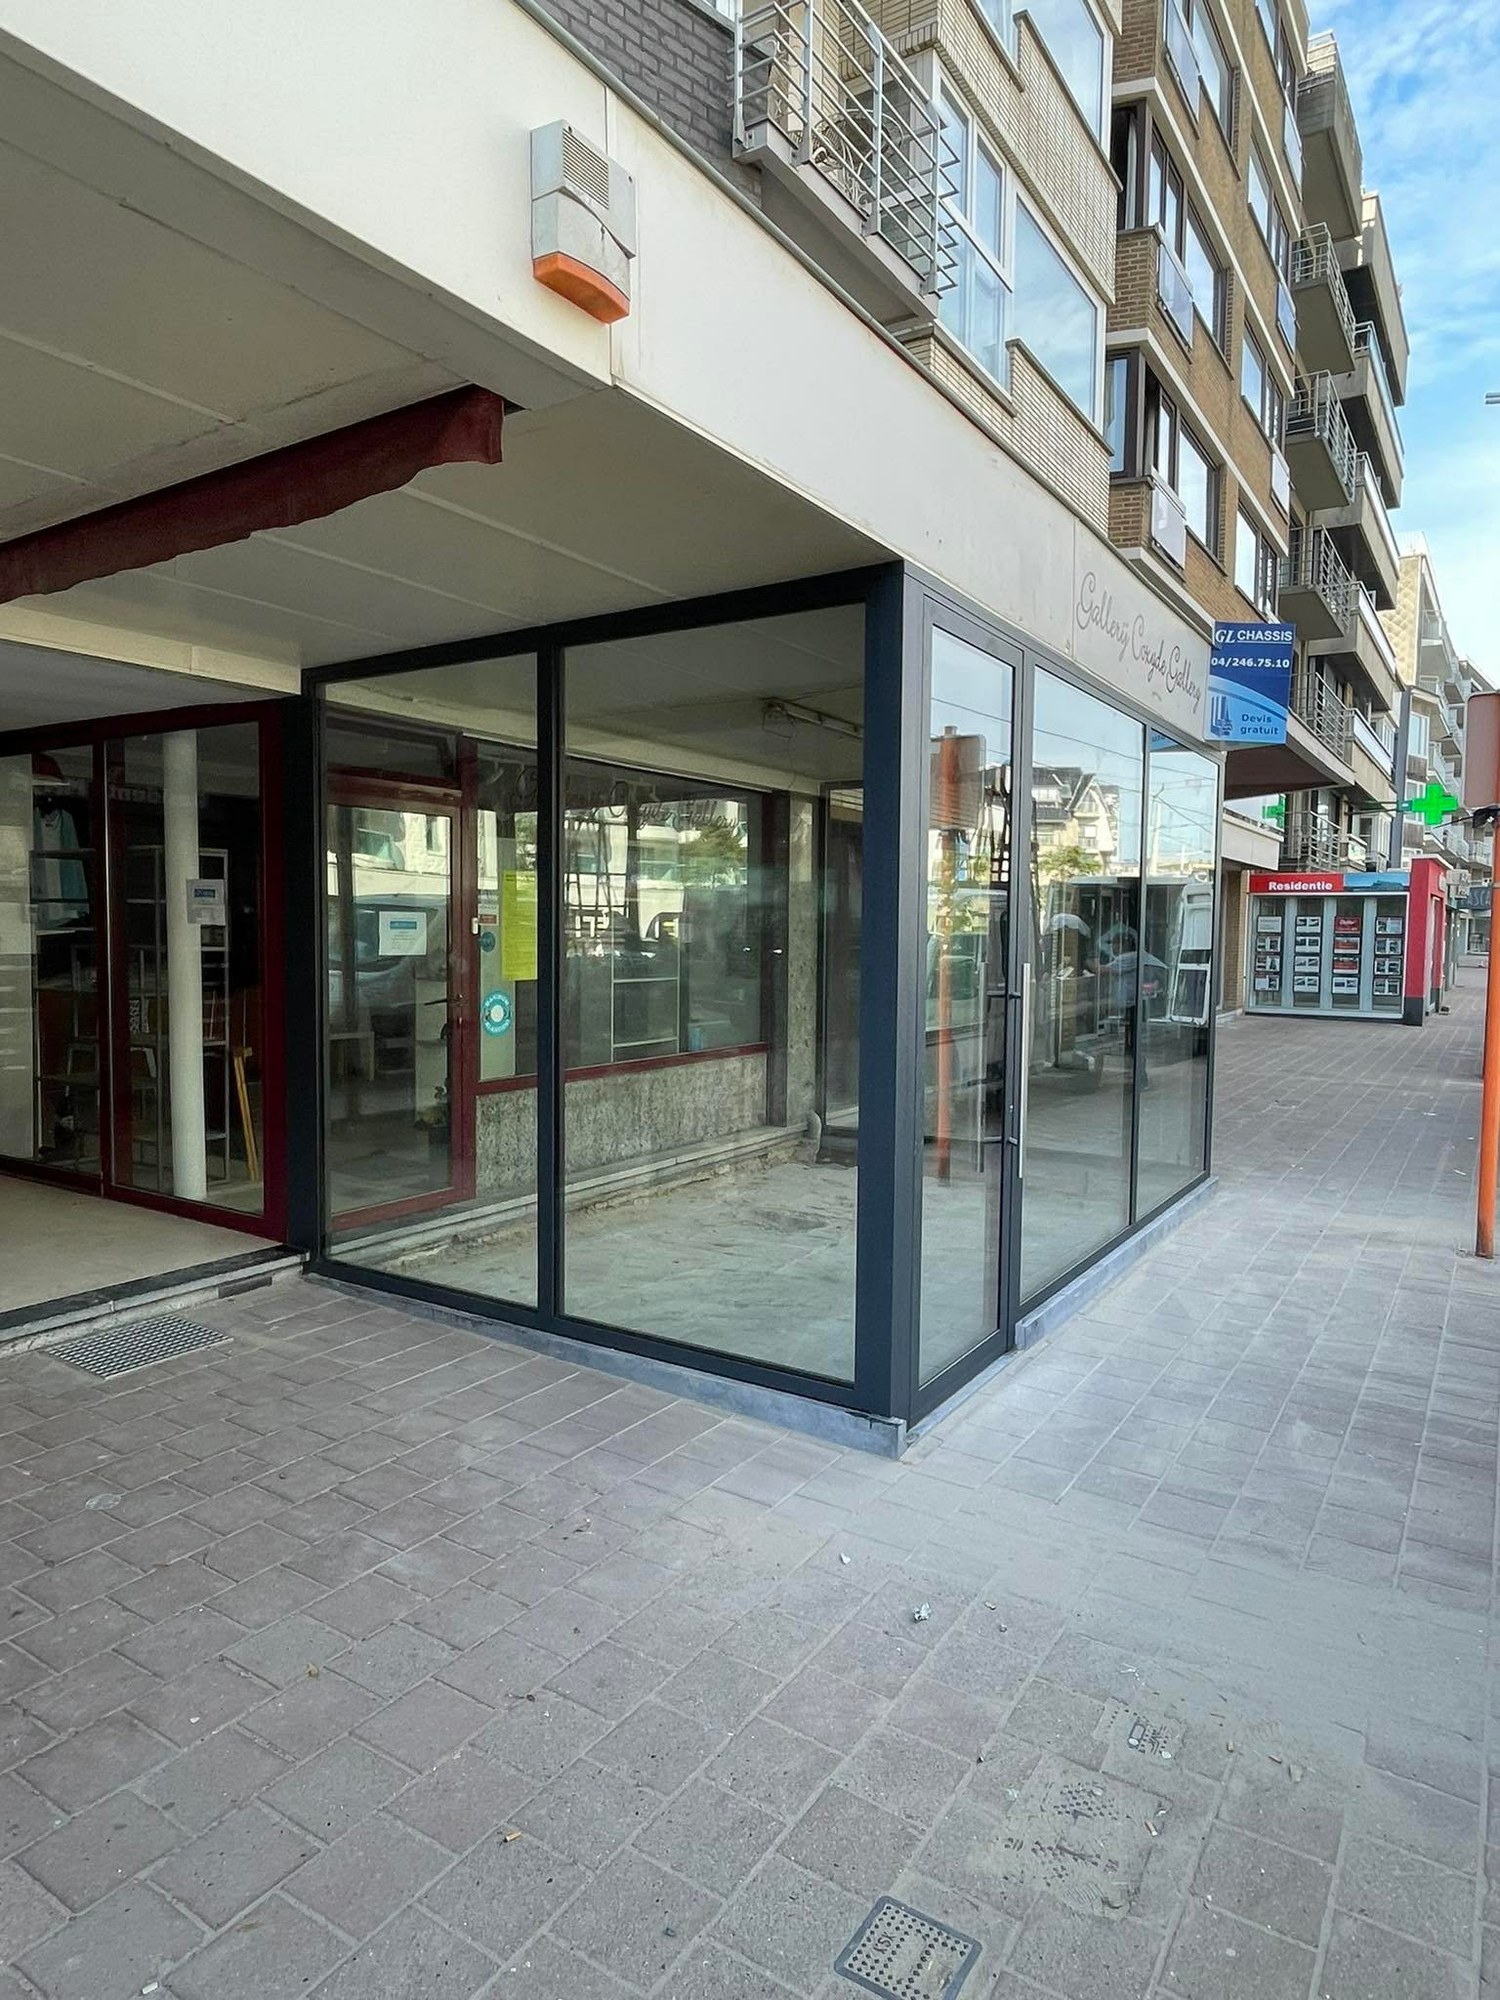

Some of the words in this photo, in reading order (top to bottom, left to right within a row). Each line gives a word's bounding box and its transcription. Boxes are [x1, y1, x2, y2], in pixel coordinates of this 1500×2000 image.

[1215, 629, 1235, 644] GL
[1237, 630, 1293, 641] CHASSIS
[1211, 657, 1290, 668] 04/246.75.10
[1165, 645, 1202, 714] Gallery
[1241, 714, 1272, 723] Devis
[1240, 726, 1279, 735] gratuit
[1268, 881, 1333, 891] Residentie
